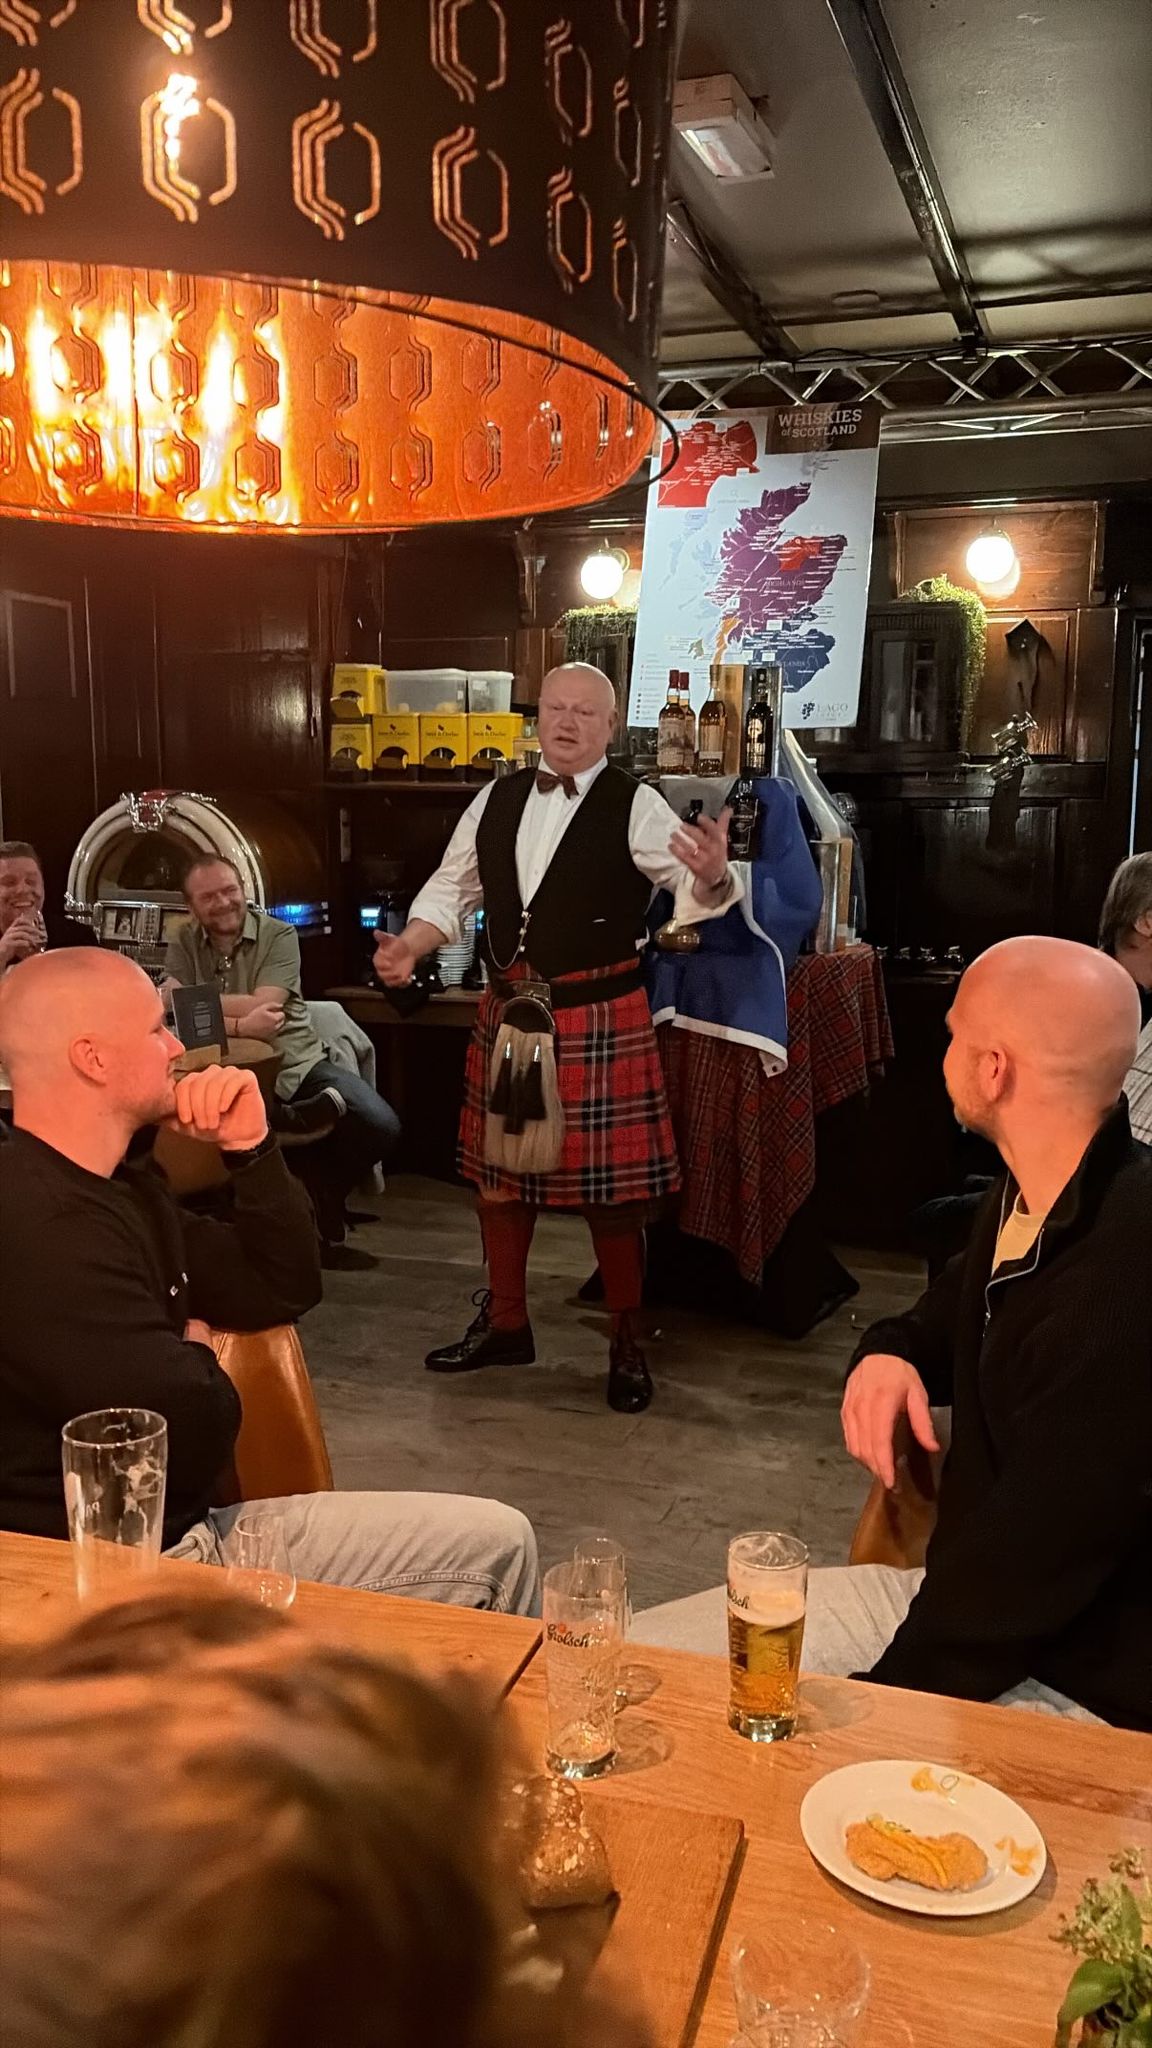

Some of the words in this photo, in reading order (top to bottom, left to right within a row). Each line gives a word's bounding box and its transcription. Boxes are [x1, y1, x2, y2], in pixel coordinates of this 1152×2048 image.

[778, 408, 863, 427] WHISKIES
[781, 428, 792, 436] of
[791, 424, 857, 438] SCOTLAND
[546, 1623, 590, 1648] Grolsch
